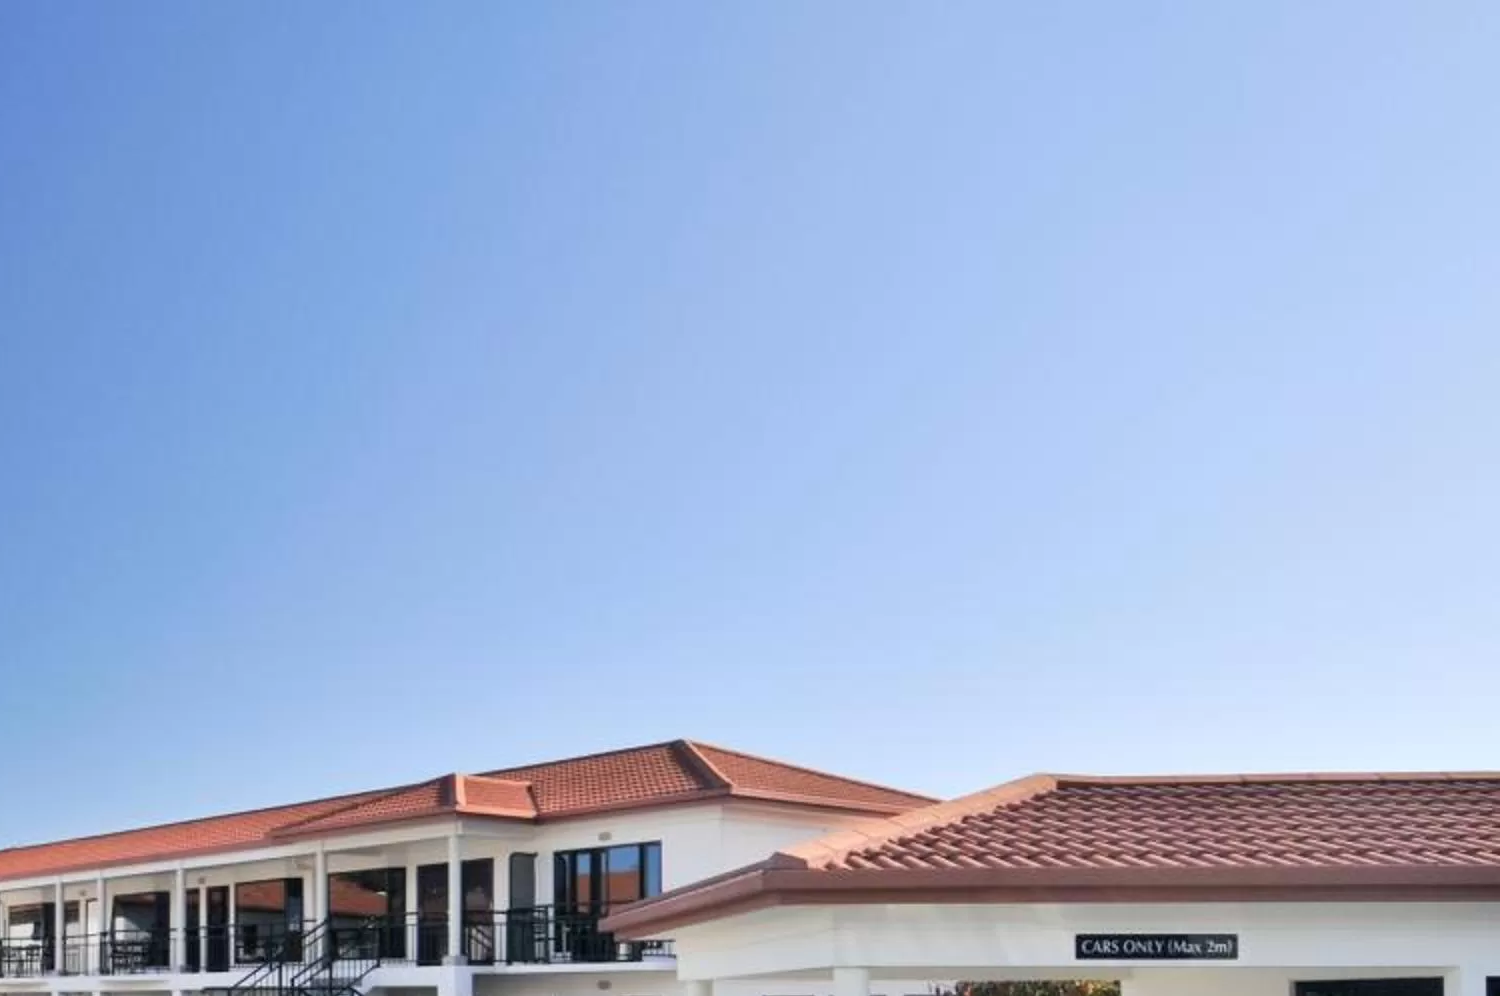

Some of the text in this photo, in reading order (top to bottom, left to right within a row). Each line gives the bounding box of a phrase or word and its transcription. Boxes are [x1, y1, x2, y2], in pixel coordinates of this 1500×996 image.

[1081, 939, 1233, 956] CARS ONLY (Max 2m)
